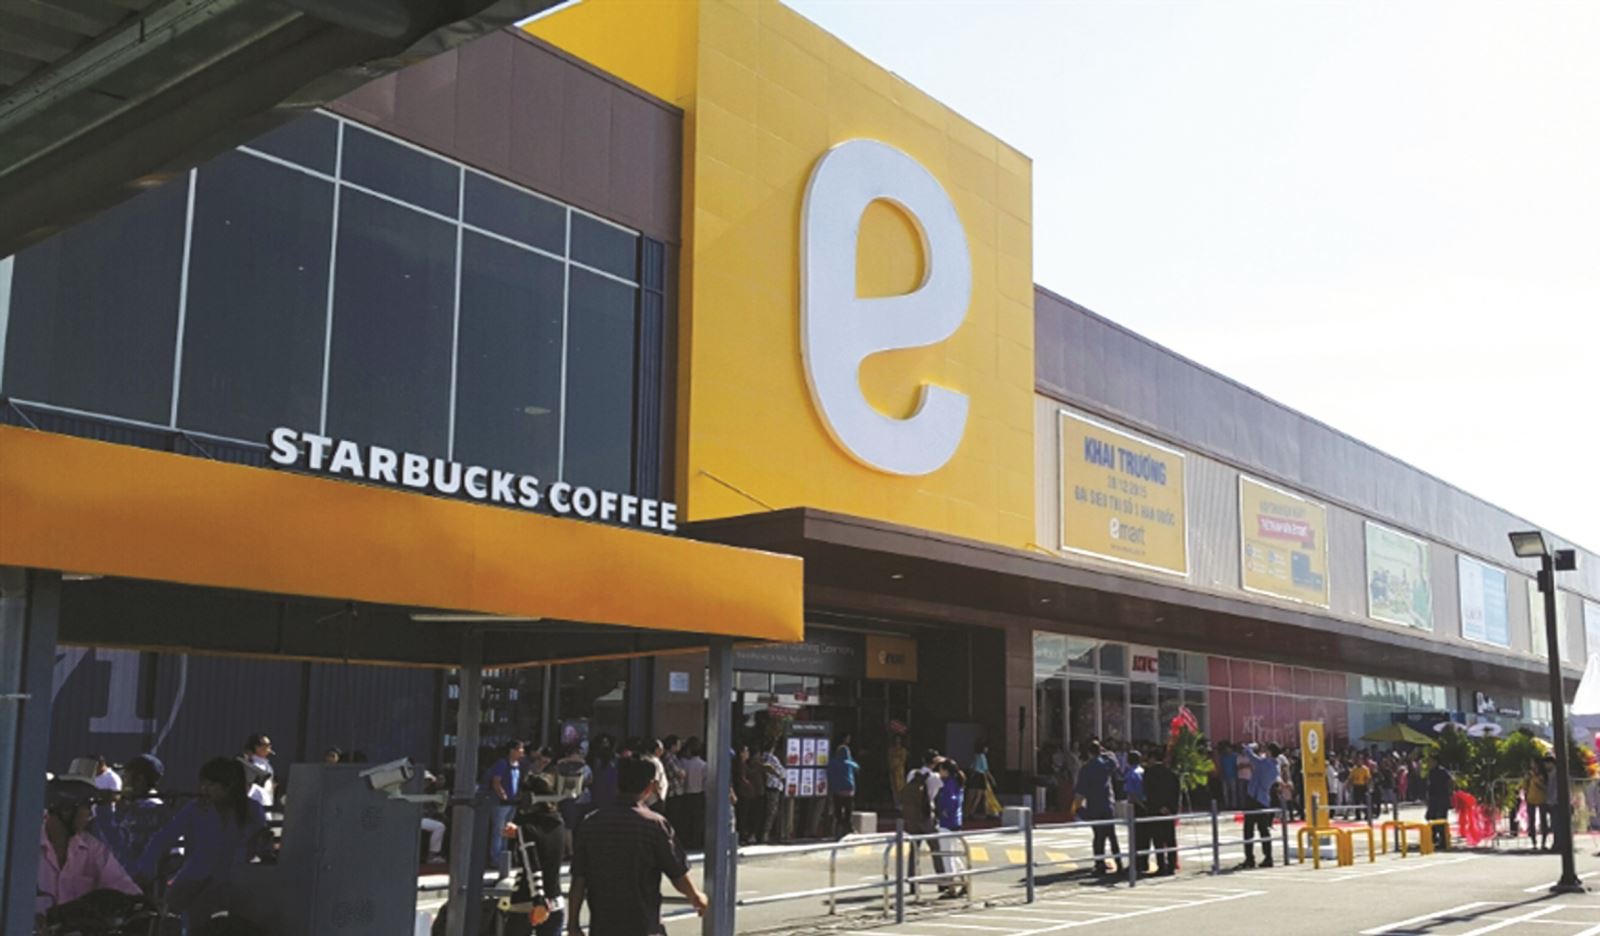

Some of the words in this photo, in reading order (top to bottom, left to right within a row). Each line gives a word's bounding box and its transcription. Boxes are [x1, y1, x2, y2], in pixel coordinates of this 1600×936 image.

[800, 138, 973, 476] e
[269, 426, 540, 508] STARBUCKS
[549, 481, 678, 532] COFFEE
[1084, 436, 1115, 470] KHAI
[1109, 517, 1145, 545] emart
